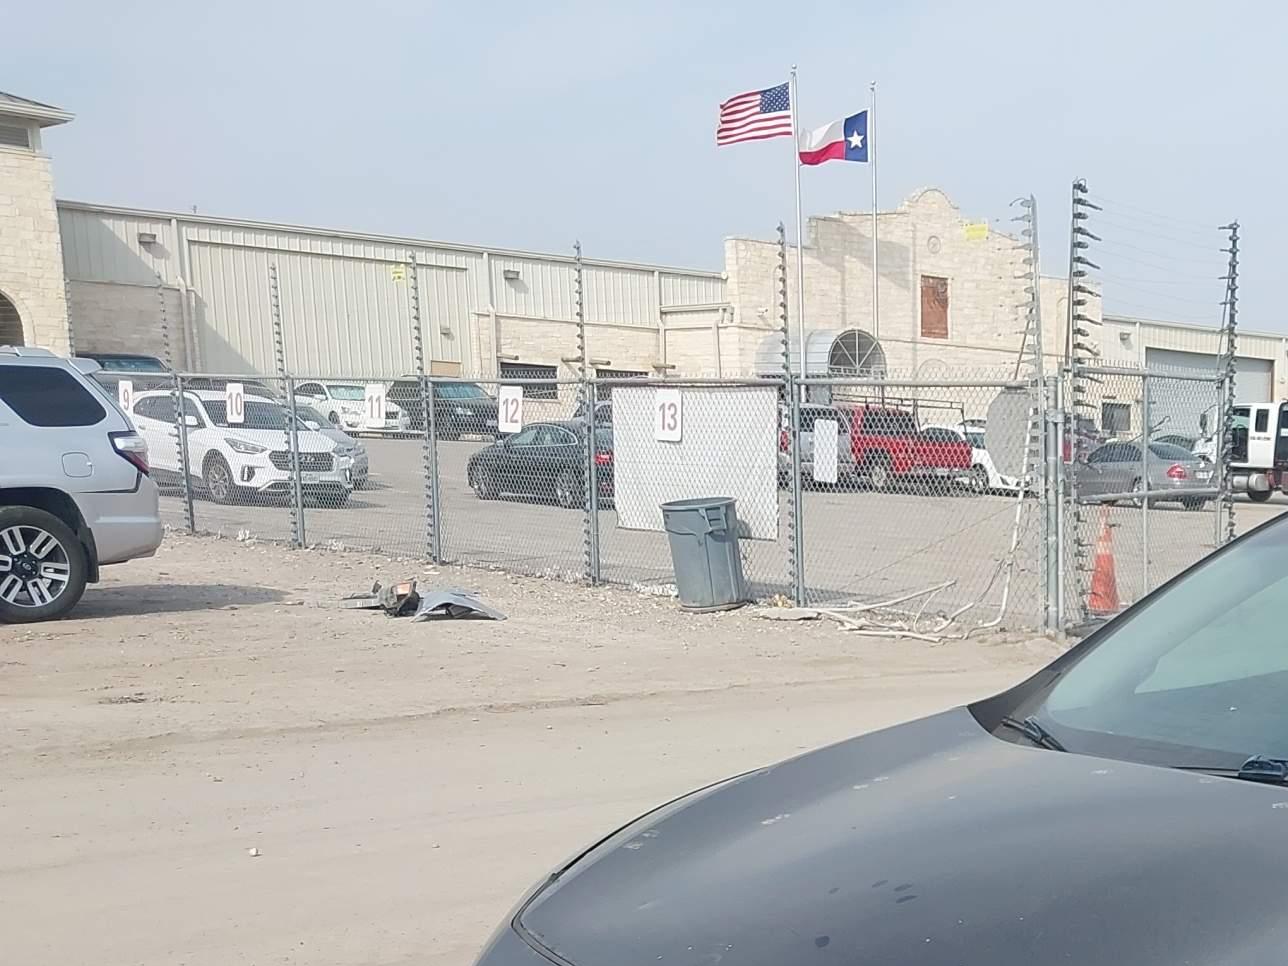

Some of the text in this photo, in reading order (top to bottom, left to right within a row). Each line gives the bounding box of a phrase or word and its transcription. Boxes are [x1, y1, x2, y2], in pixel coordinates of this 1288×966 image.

[123, 388, 130, 411] 9
[228, 391, 243, 417] 10
[367, 394, 382, 419] 11
[502, 397, 520, 424] 12
[658, 402, 678, 431] 13
